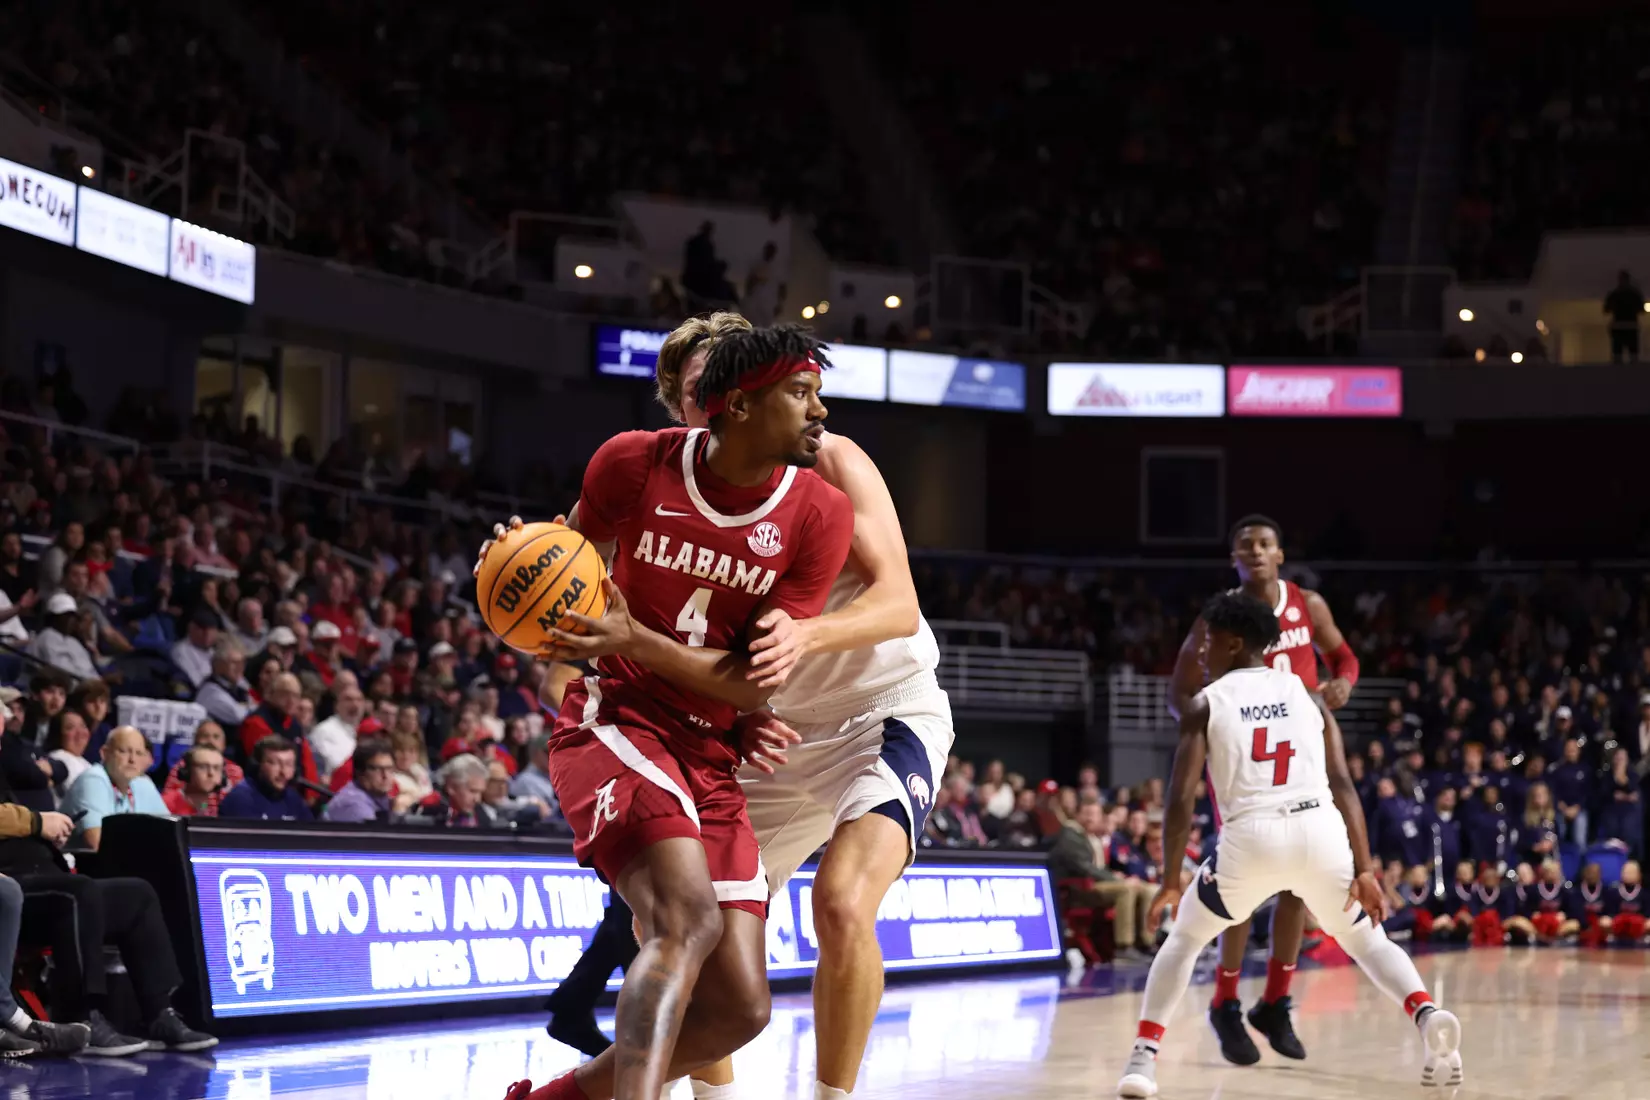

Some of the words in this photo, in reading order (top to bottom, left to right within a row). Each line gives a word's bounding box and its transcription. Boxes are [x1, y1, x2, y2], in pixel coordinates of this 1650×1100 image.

[633, 530, 777, 596] ALABAMA
[755, 524, 779, 548] SEC
[496, 544, 565, 613] Wilson
[537, 576, 587, 632] NCAA
[675, 587, 713, 647] 4
[1240, 703, 1288, 722] MOORE
[1250, 727, 1296, 787] 4
[285, 874, 369, 934] TWO
[374, 875, 447, 933] MEN
[453, 875, 518, 931] AND
[522, 876, 548, 930] A
[369, 938, 471, 990] MOVERS
